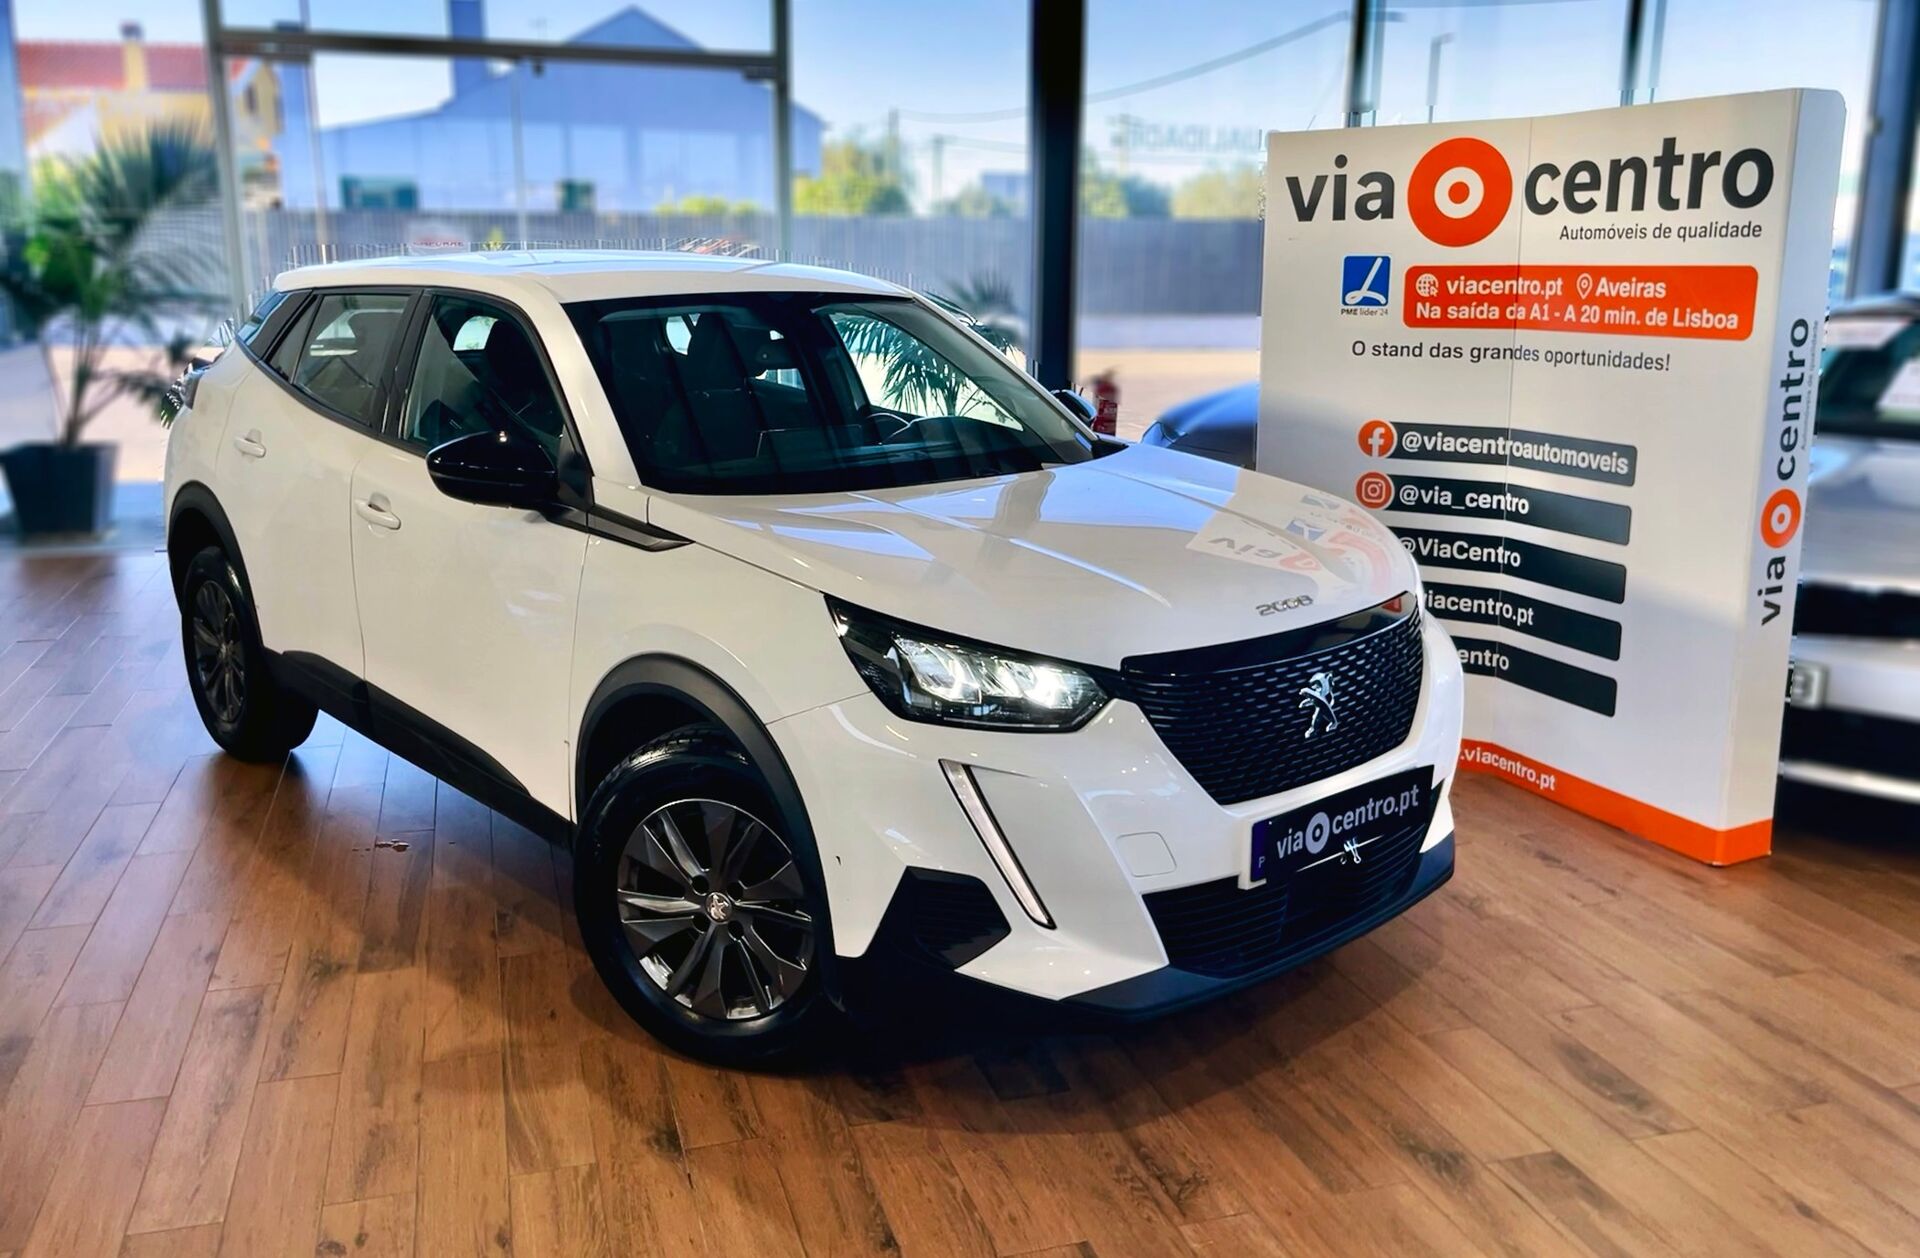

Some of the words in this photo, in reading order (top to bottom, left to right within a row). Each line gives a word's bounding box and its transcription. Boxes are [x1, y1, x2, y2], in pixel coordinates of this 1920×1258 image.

[1285, 154, 1395, 222] via
[1524, 137, 1774, 215] centro
[1560, 224, 1648, 240] Automóveis
[1652, 223, 1672, 238] de
[1677, 221, 1762, 242] qualidade
[1446, 276, 1563, 299] viacentro.pt
[1595, 277, 1667, 298] Aveiras
[1340, 308, 1358, 316] PME
[1416, 303, 1441, 319] Na
[1447, 302, 1499, 319] saída
[1506, 303, 1526, 319] da
[1530, 304, 1549, 321] A1
[1564, 304, 1576, 322] A
[1580, 305, 1600, 323] 20
[1604, 306, 1641, 325] min.
[1645, 307, 1667, 326] de
[1673, 308, 1738, 329] Lisboa
[1352, 340, 1365, 356] O
[1372, 342, 1423, 358] stand
[1429, 343, 1463, 359] das
[1470, 345, 1539, 363] grandes
[1544, 350, 1670, 371] oportunidades!
[1402, 431, 1629, 475] @viacentroautomoveis
[1757, 556, 1786, 625] via
[1776, 318, 1809, 481] centro
[1399, 485, 1530, 514] @via_centro
[1400, 537, 1521, 567] @ViaCentro
[1256, 595, 1314, 616] 2008
[1458, 649, 1509, 670] entro
[1459, 747, 1555, 790] .viacentro.pt
[1277, 828, 1303, 859] via
[1332, 784, 1419, 834] centro.pt
[1258, 856, 1266, 868] P
